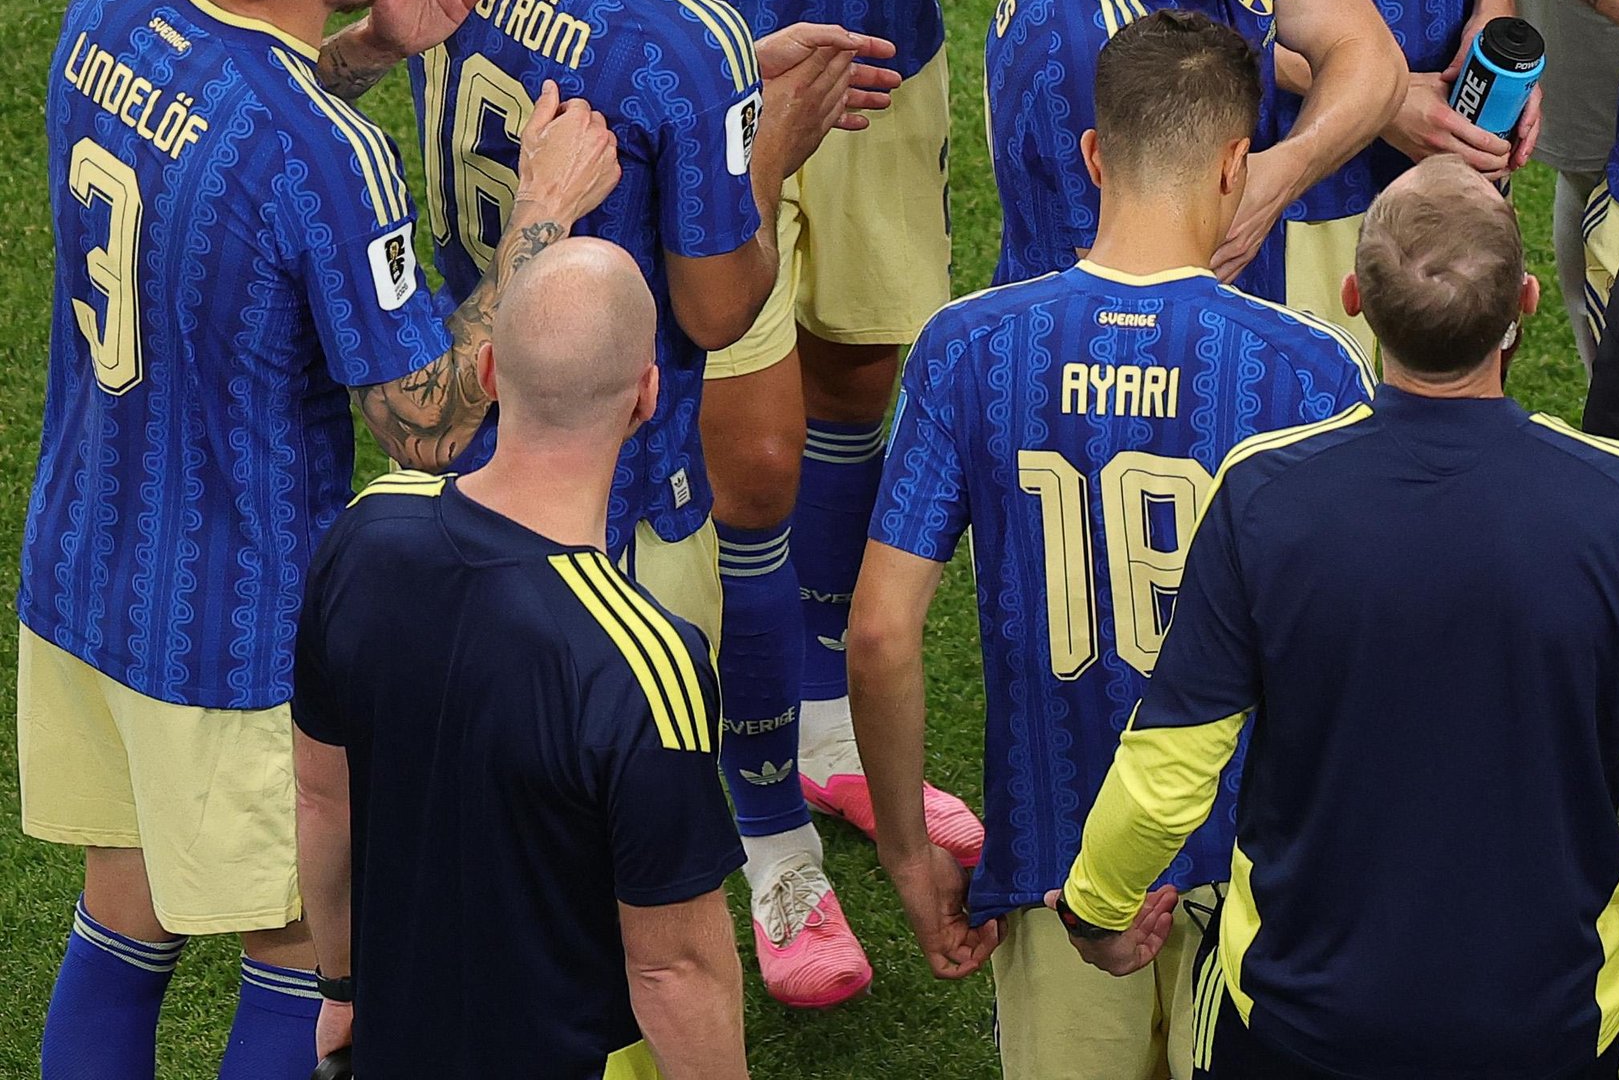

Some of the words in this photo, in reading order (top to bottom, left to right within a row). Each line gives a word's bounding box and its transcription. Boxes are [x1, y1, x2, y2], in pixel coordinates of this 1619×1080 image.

[65, 32, 209, 160] LINDELÖF
[149, 17, 191, 54] SVERIGE
[419, 40, 536, 277] 16
[69, 136, 144, 397] 3
[1098, 311, 1157, 327] SVERIGE
[1062, 362, 1180, 418] AYARI
[1017, 450, 1213, 681] 18
